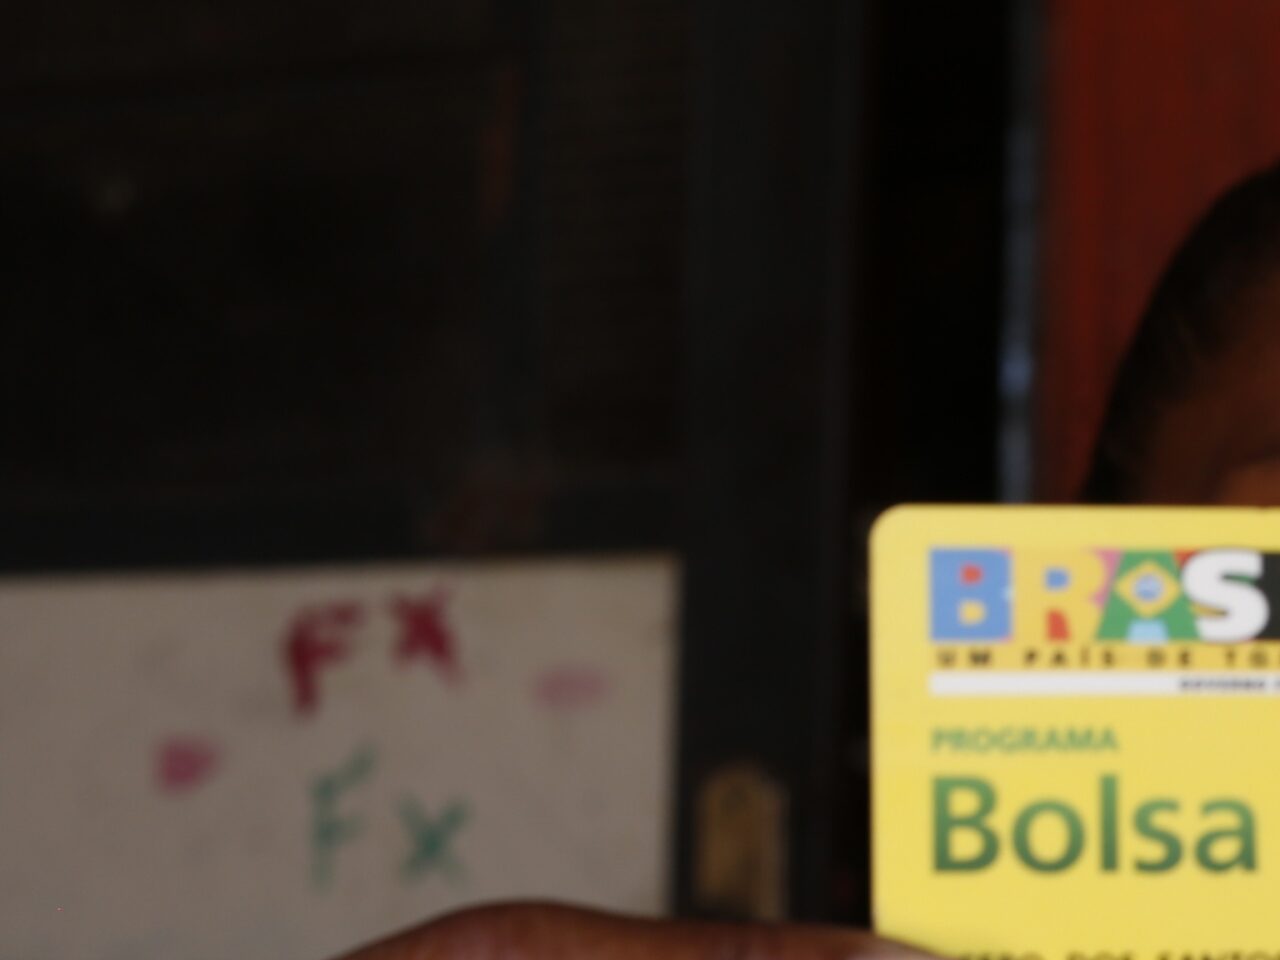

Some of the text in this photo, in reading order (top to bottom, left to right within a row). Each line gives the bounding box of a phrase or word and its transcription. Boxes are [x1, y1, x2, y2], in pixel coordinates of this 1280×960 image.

[937, 648, 993, 668] UM
[1147, 648, 1194, 668] DE
[931, 728, 1119, 754] PROGRAMA
[931, 774, 1258, 875] Bolsa
